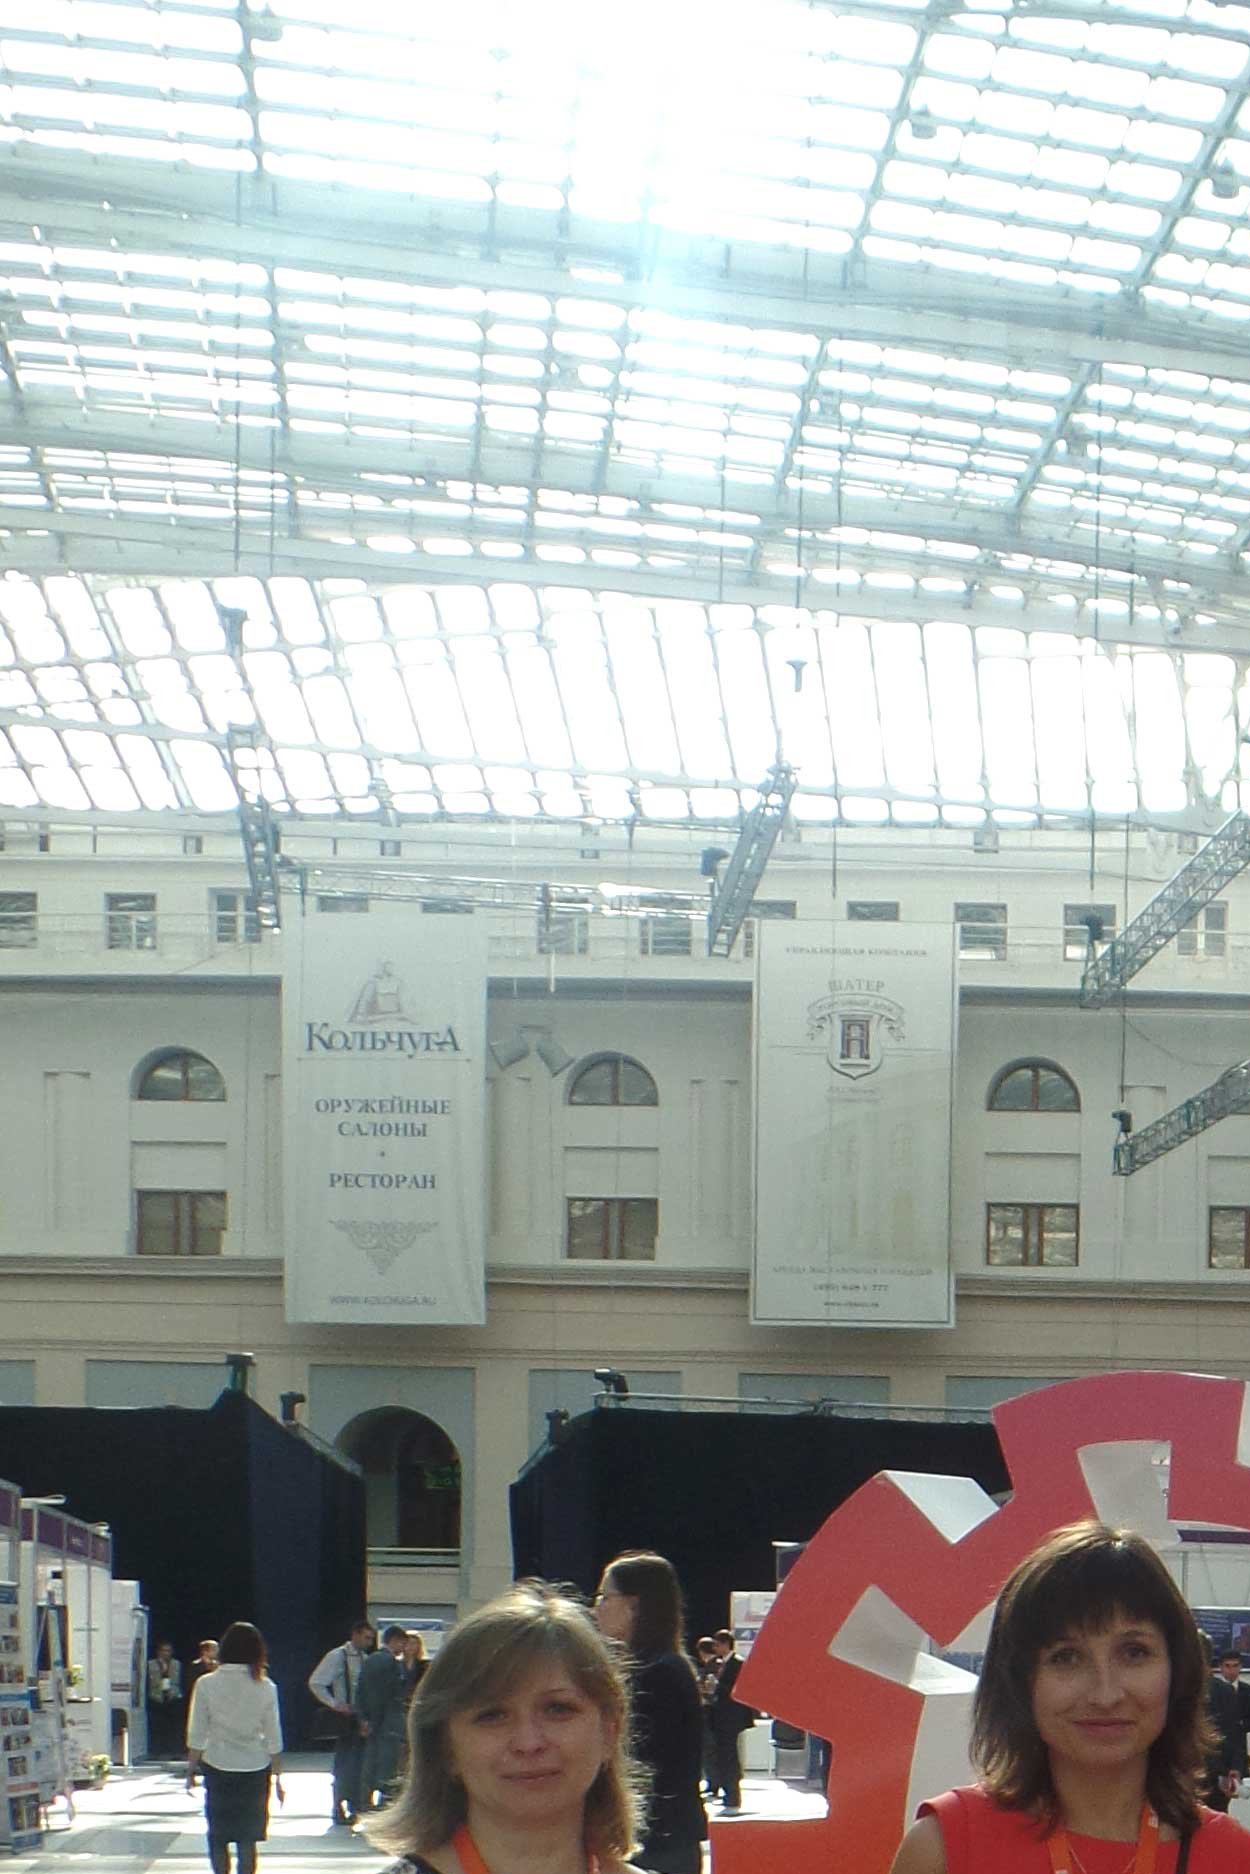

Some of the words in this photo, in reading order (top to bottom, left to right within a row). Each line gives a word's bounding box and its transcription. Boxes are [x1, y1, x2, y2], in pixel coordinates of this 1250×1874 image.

[828, 979, 885, 993] ШАТЕР
[314, 1096, 452, 1116] ОРУЖЕЙНЫЕ
[337, 1120, 428, 1138] САЛОНЫ
[329, 1172, 437, 1190] РЕСТОРАН
